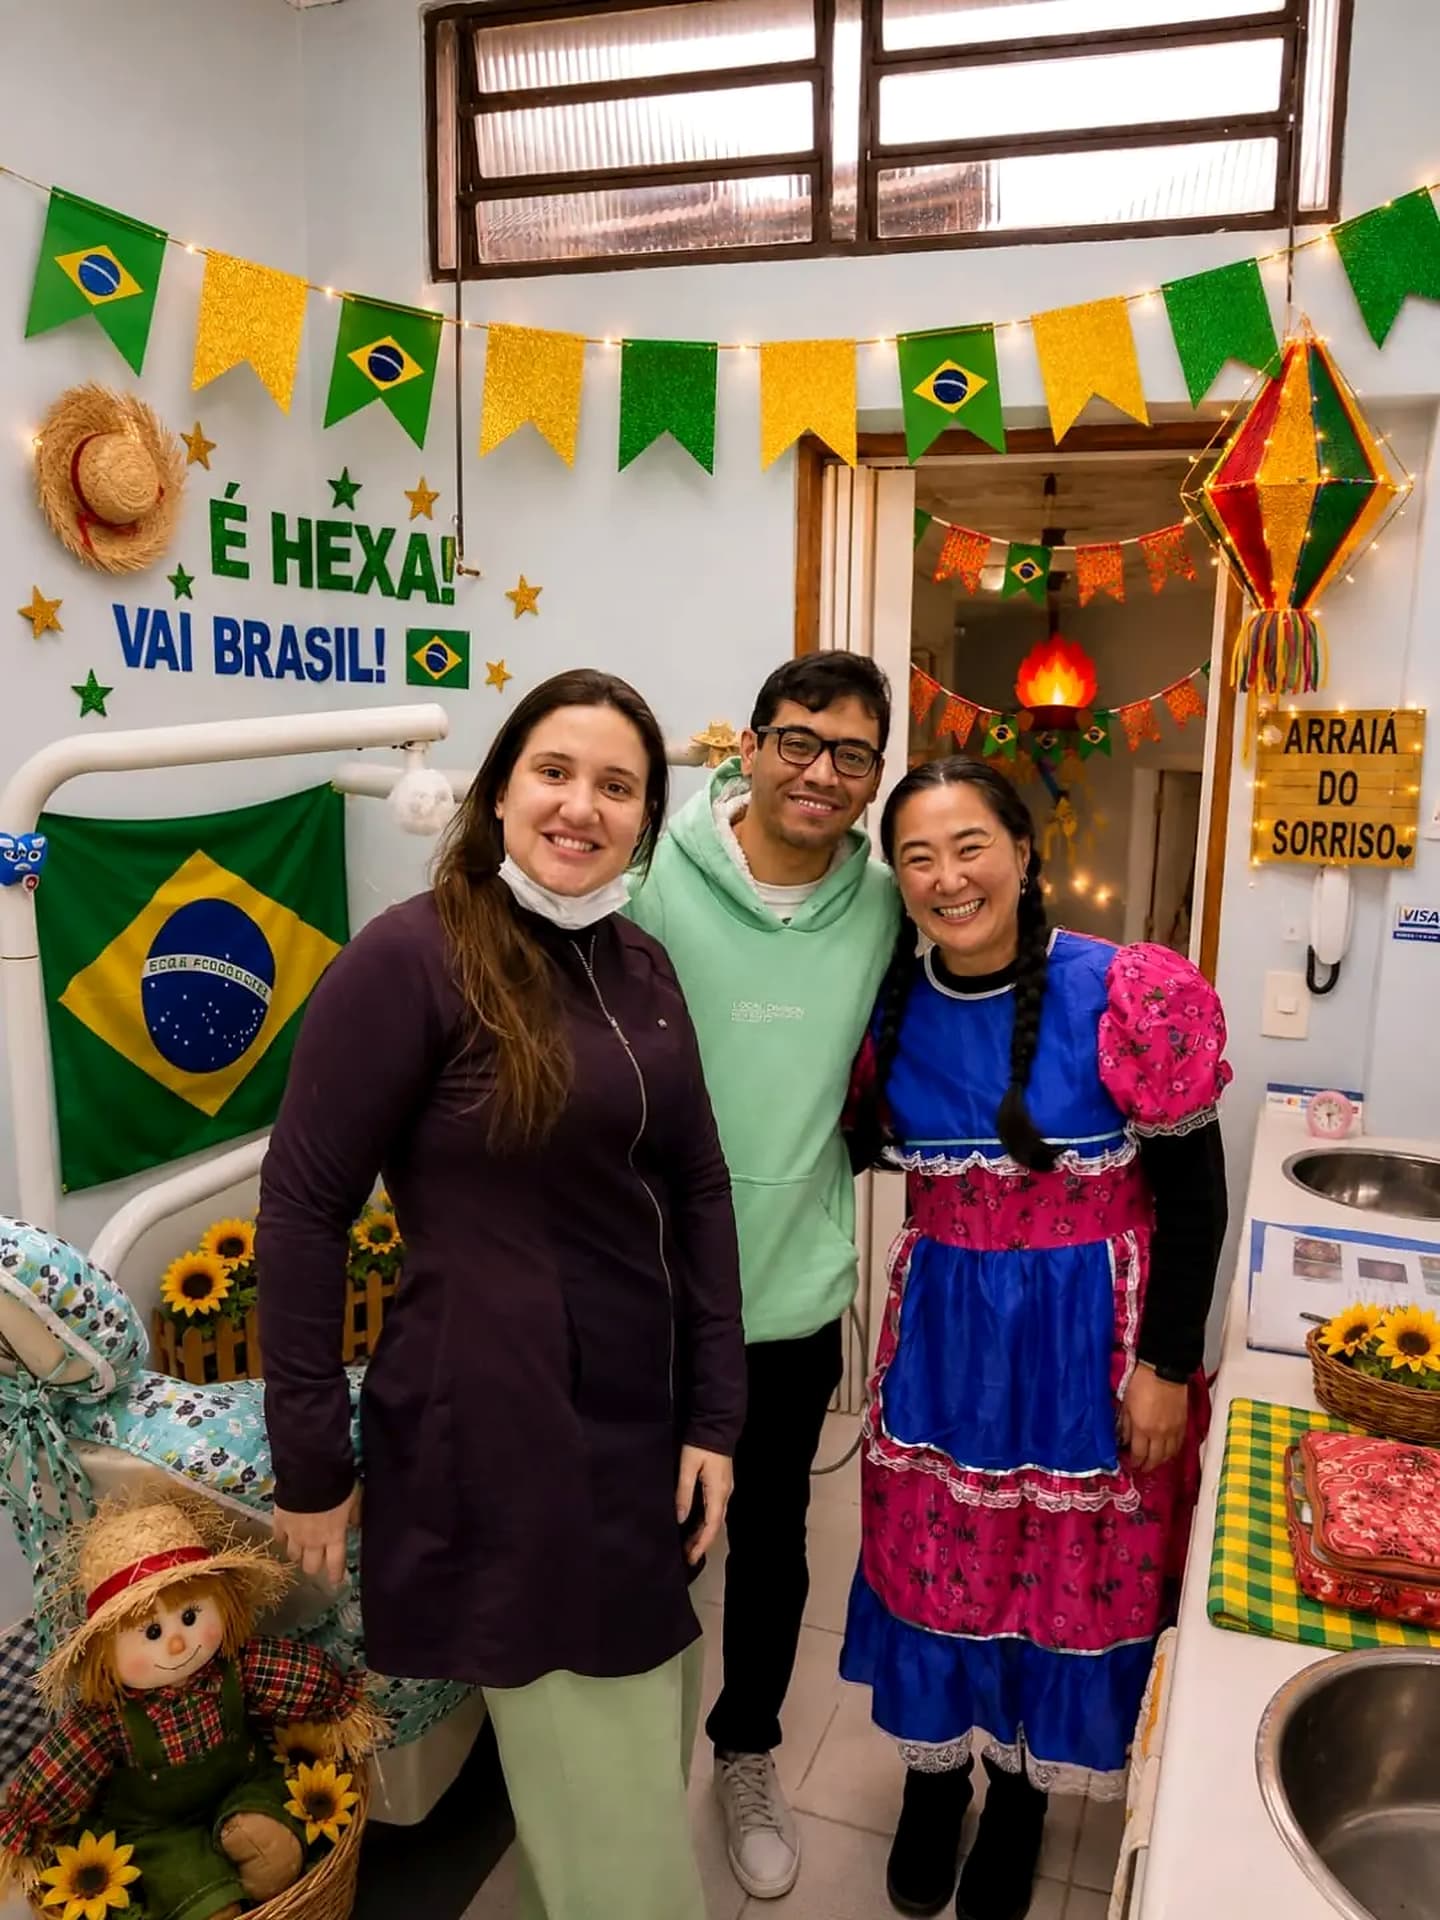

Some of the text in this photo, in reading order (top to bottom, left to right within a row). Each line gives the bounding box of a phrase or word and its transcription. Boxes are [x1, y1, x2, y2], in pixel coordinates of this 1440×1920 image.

[209, 482, 456, 605] É HEXA!
[112, 603, 386, 684] VAI BRASIL!
[1284, 711, 1398, 754] ARRAIÁ
[1318, 770, 1358, 806] DO
[1272, 819, 1396, 859] SORRISO
[1403, 909, 1439, 923] VISA
